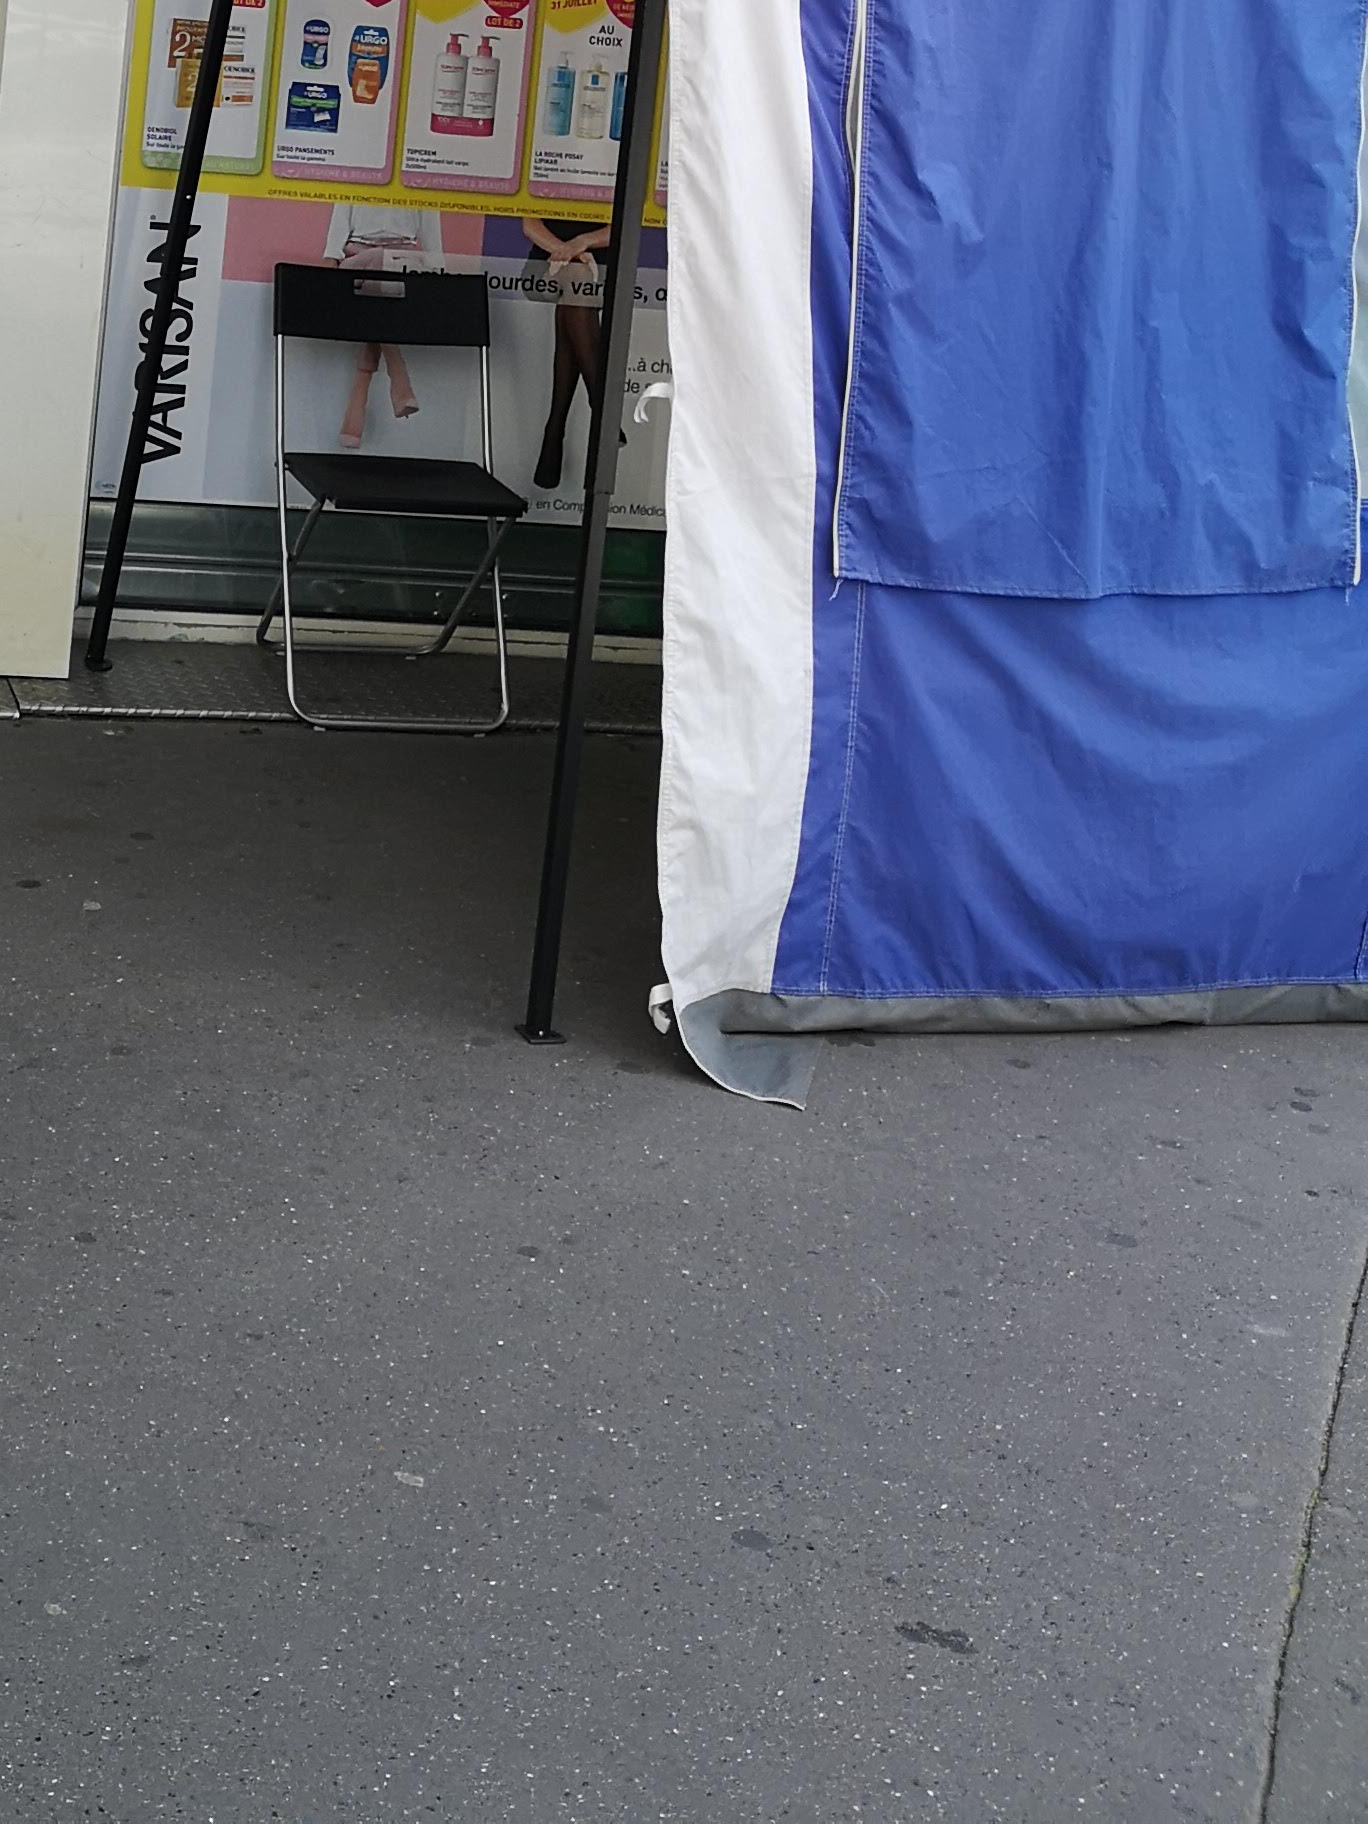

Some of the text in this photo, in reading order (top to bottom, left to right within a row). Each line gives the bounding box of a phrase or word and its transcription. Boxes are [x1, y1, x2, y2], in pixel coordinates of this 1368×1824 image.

[599, 25, 615, 35] AU
[360, 35, 388, 45] URGO
[588, 36, 623, 47] CHOIX
[485, 271, 564, 297] ourdes,
